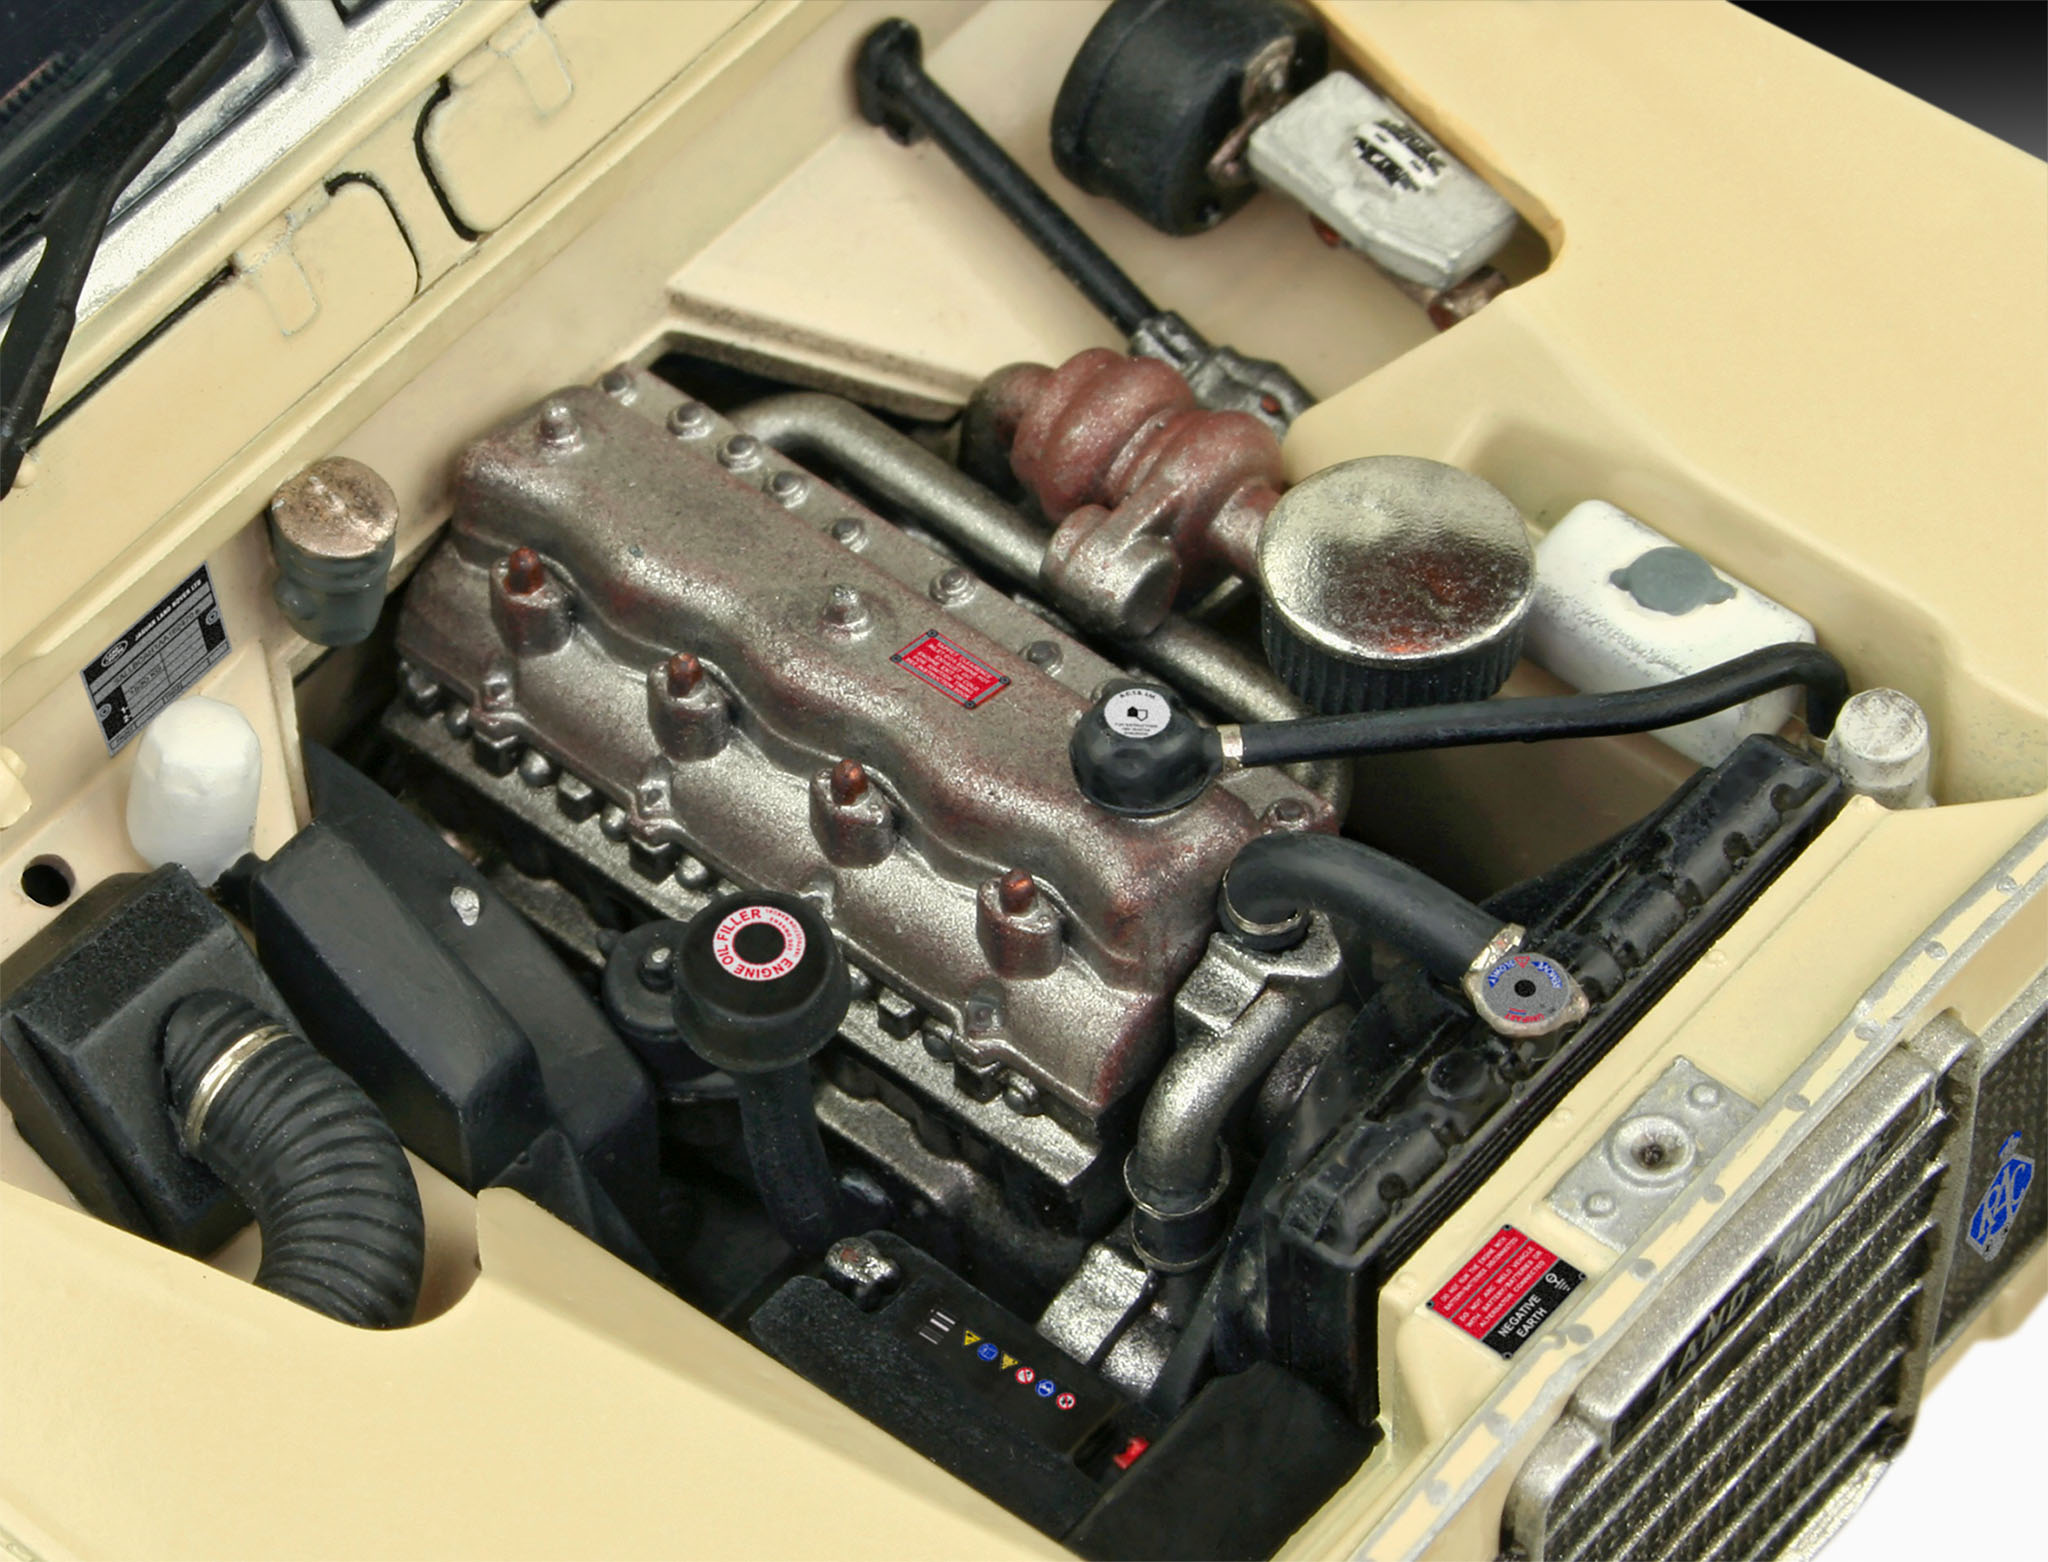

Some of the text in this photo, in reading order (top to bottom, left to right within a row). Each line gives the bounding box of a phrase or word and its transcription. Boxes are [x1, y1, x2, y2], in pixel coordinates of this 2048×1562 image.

[135, 578, 201, 640] JAGUAR LAND ROVER LTD
[716, 908, 762, 942] FILLER
[716, 944, 734, 966] OIL
[733, 956, 794, 979] ENGINE
[1504, 1013, 1545, 1023] UNIPART
[1449, 1284, 1459, 1293] NOT
[1469, 1264, 1479, 1273] THE
[1459, 1246, 1534, 1321] DO NOT ARC WELD VEHICLE
[1513, 1260, 1545, 1292] CONNECTED
[1466, 1313, 1481, 1327] WITH
[1497, 1294, 1541, 1337] NEGATIVE
[1516, 1307, 1547, 1337] EARTH
[1657, 1281, 1751, 1400] LAND
